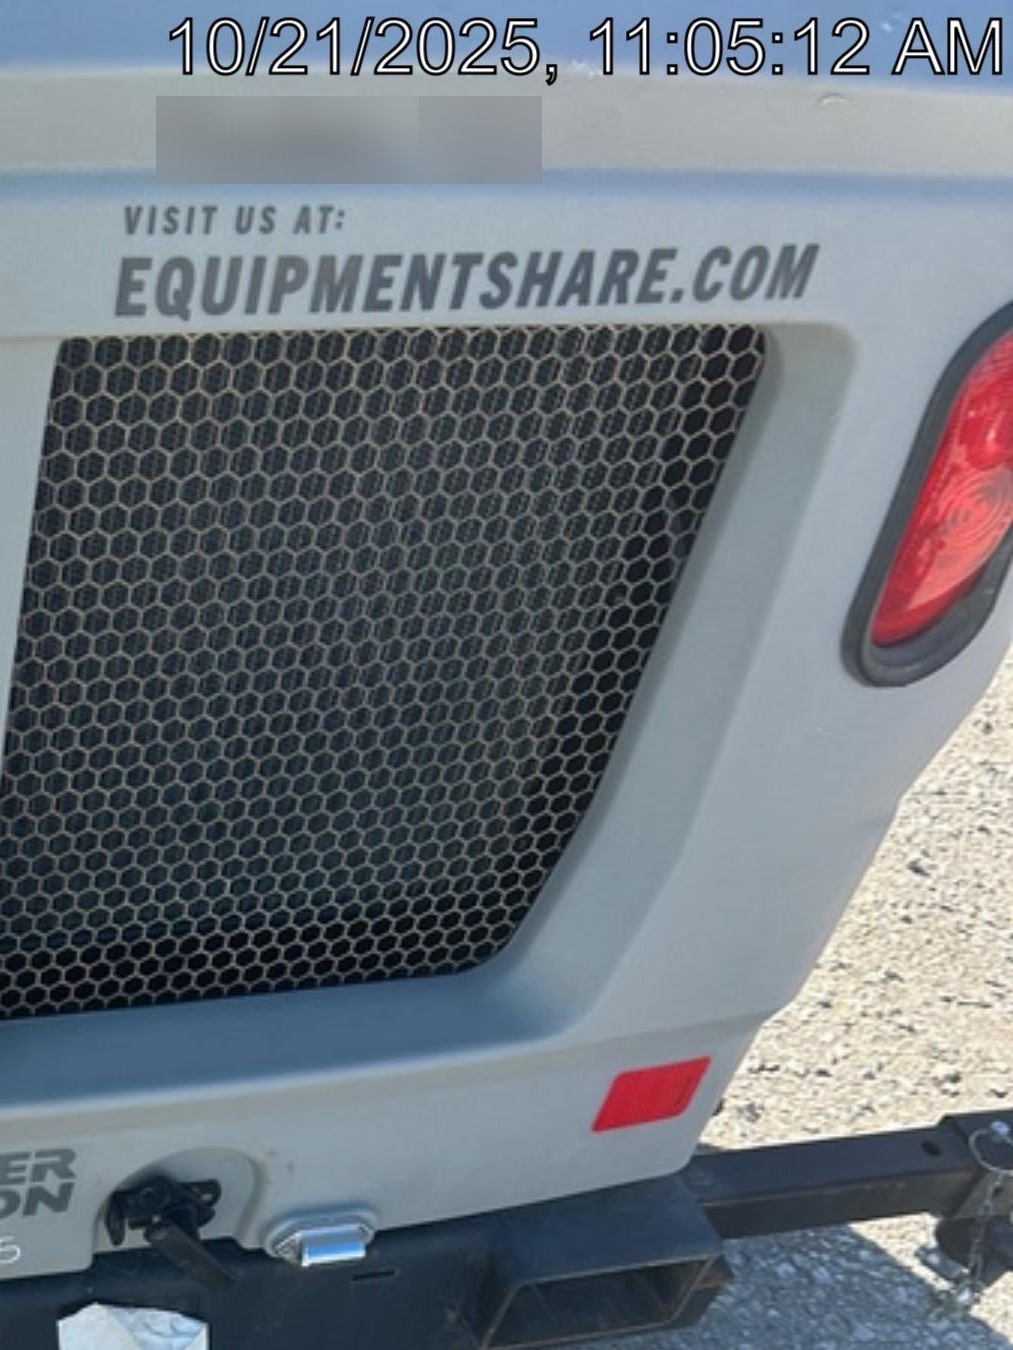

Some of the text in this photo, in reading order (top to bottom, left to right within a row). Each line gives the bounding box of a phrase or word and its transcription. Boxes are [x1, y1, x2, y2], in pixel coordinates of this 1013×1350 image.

[124, 204, 346, 236] VISIT US AT:
[114, 243, 820, 320] EQUIPMENTSHARE.COM
